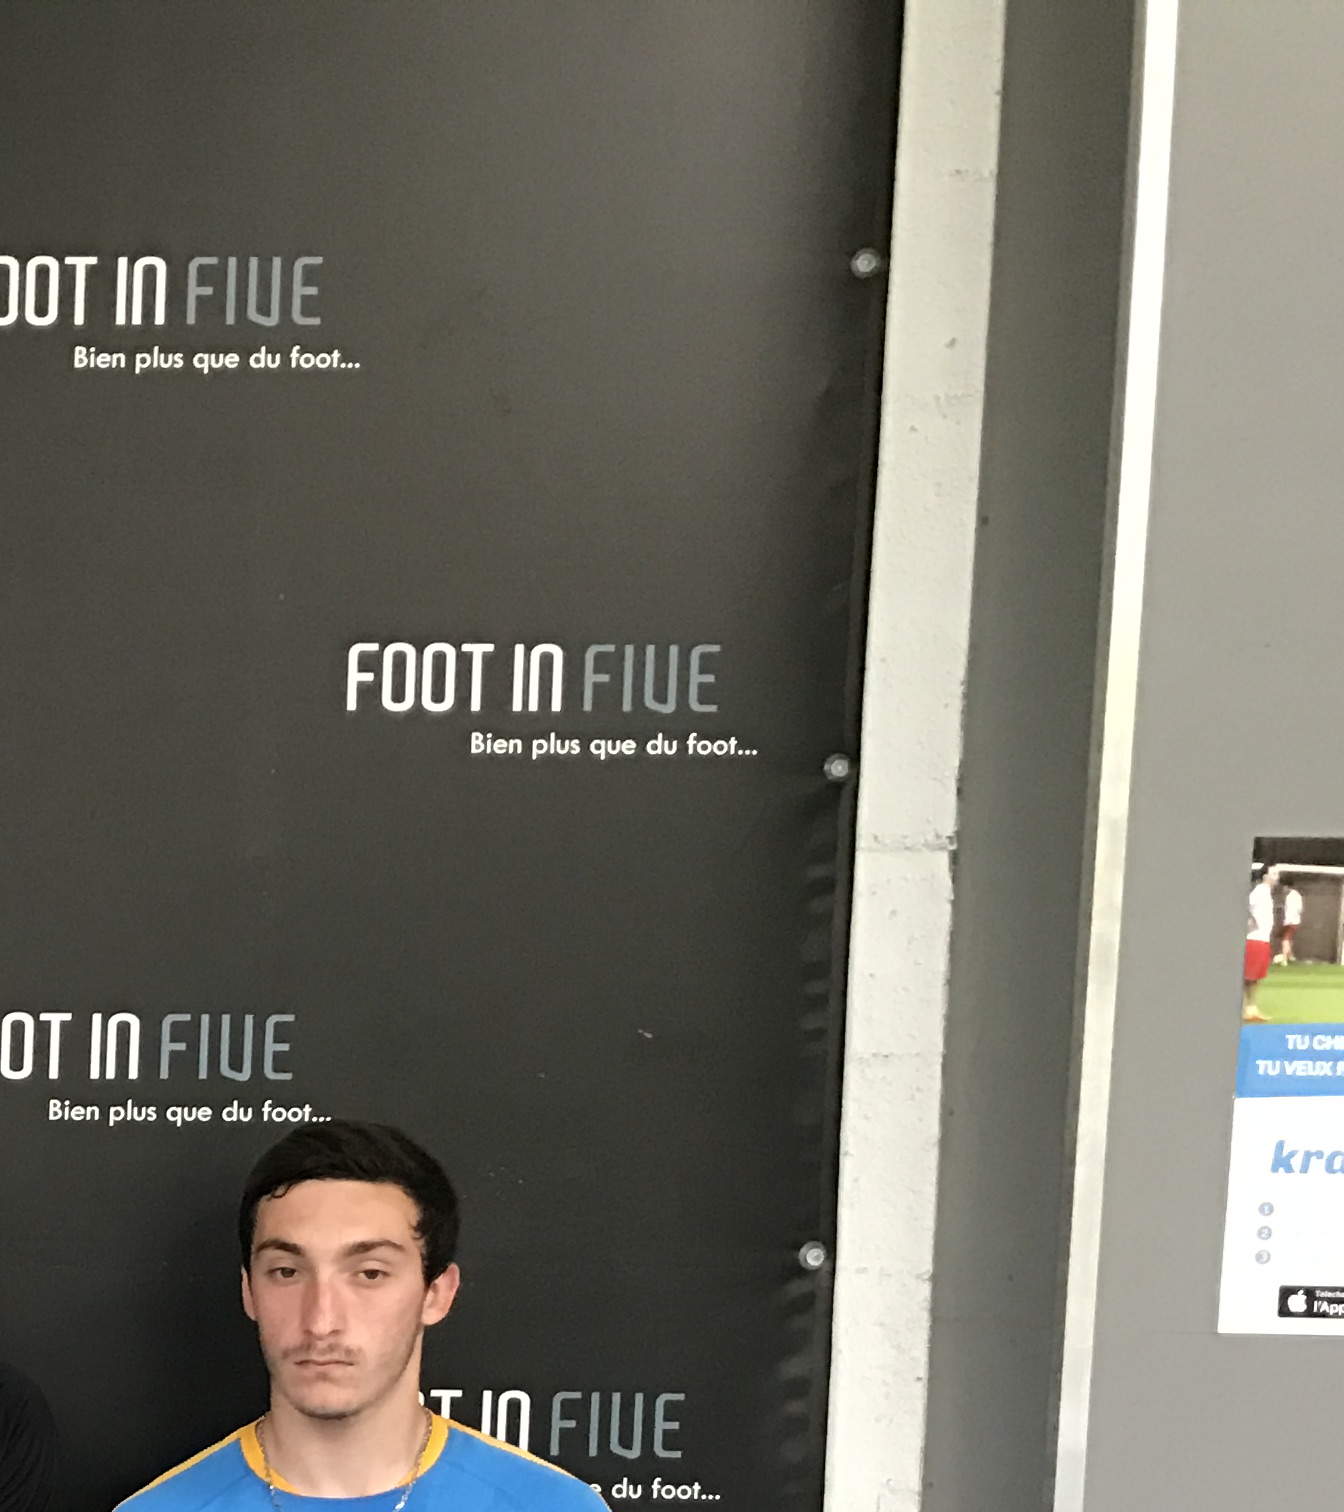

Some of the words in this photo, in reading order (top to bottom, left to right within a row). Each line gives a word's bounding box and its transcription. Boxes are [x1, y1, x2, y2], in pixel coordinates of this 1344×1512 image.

[115, 255, 168, 327] IN
[186, 256, 324, 327] FIVE
[73, 346, 126, 369] Bien
[135, 346, 184, 374] plus
[193, 352, 240, 375] que
[249, 346, 281, 369] du
[289, 345, 361, 370] foot...
[346, 642, 495, 713] FOOT
[512, 643, 564, 713] IN
[582, 644, 722, 715] FIVE
[470, 732, 522, 755] Bien
[531, 732, 581, 761] plus
[589, 738, 637, 761] que
[646, 732, 678, 756] du
[686, 732, 758, 757] foot...
[89, 1012, 141, 1080] IN
[159, 1013, 296, 1082] FIVE
[1285, 1034, 1309, 1050] TU
[1255, 1059, 1281, 1076] TU
[1283, 1060, 1334, 1077] VEUX
[48, 1099, 100, 1122] Bien
[108, 1099, 157, 1127] plus
[166, 1105, 213, 1128] que
[221, 1100, 253, 1123] du
[262, 1099, 333, 1123] foot...
[550, 1391, 686, 1460] FIVE
[611, 1477, 643, 1500] du
[652, 1477, 722, 1502] foot...
